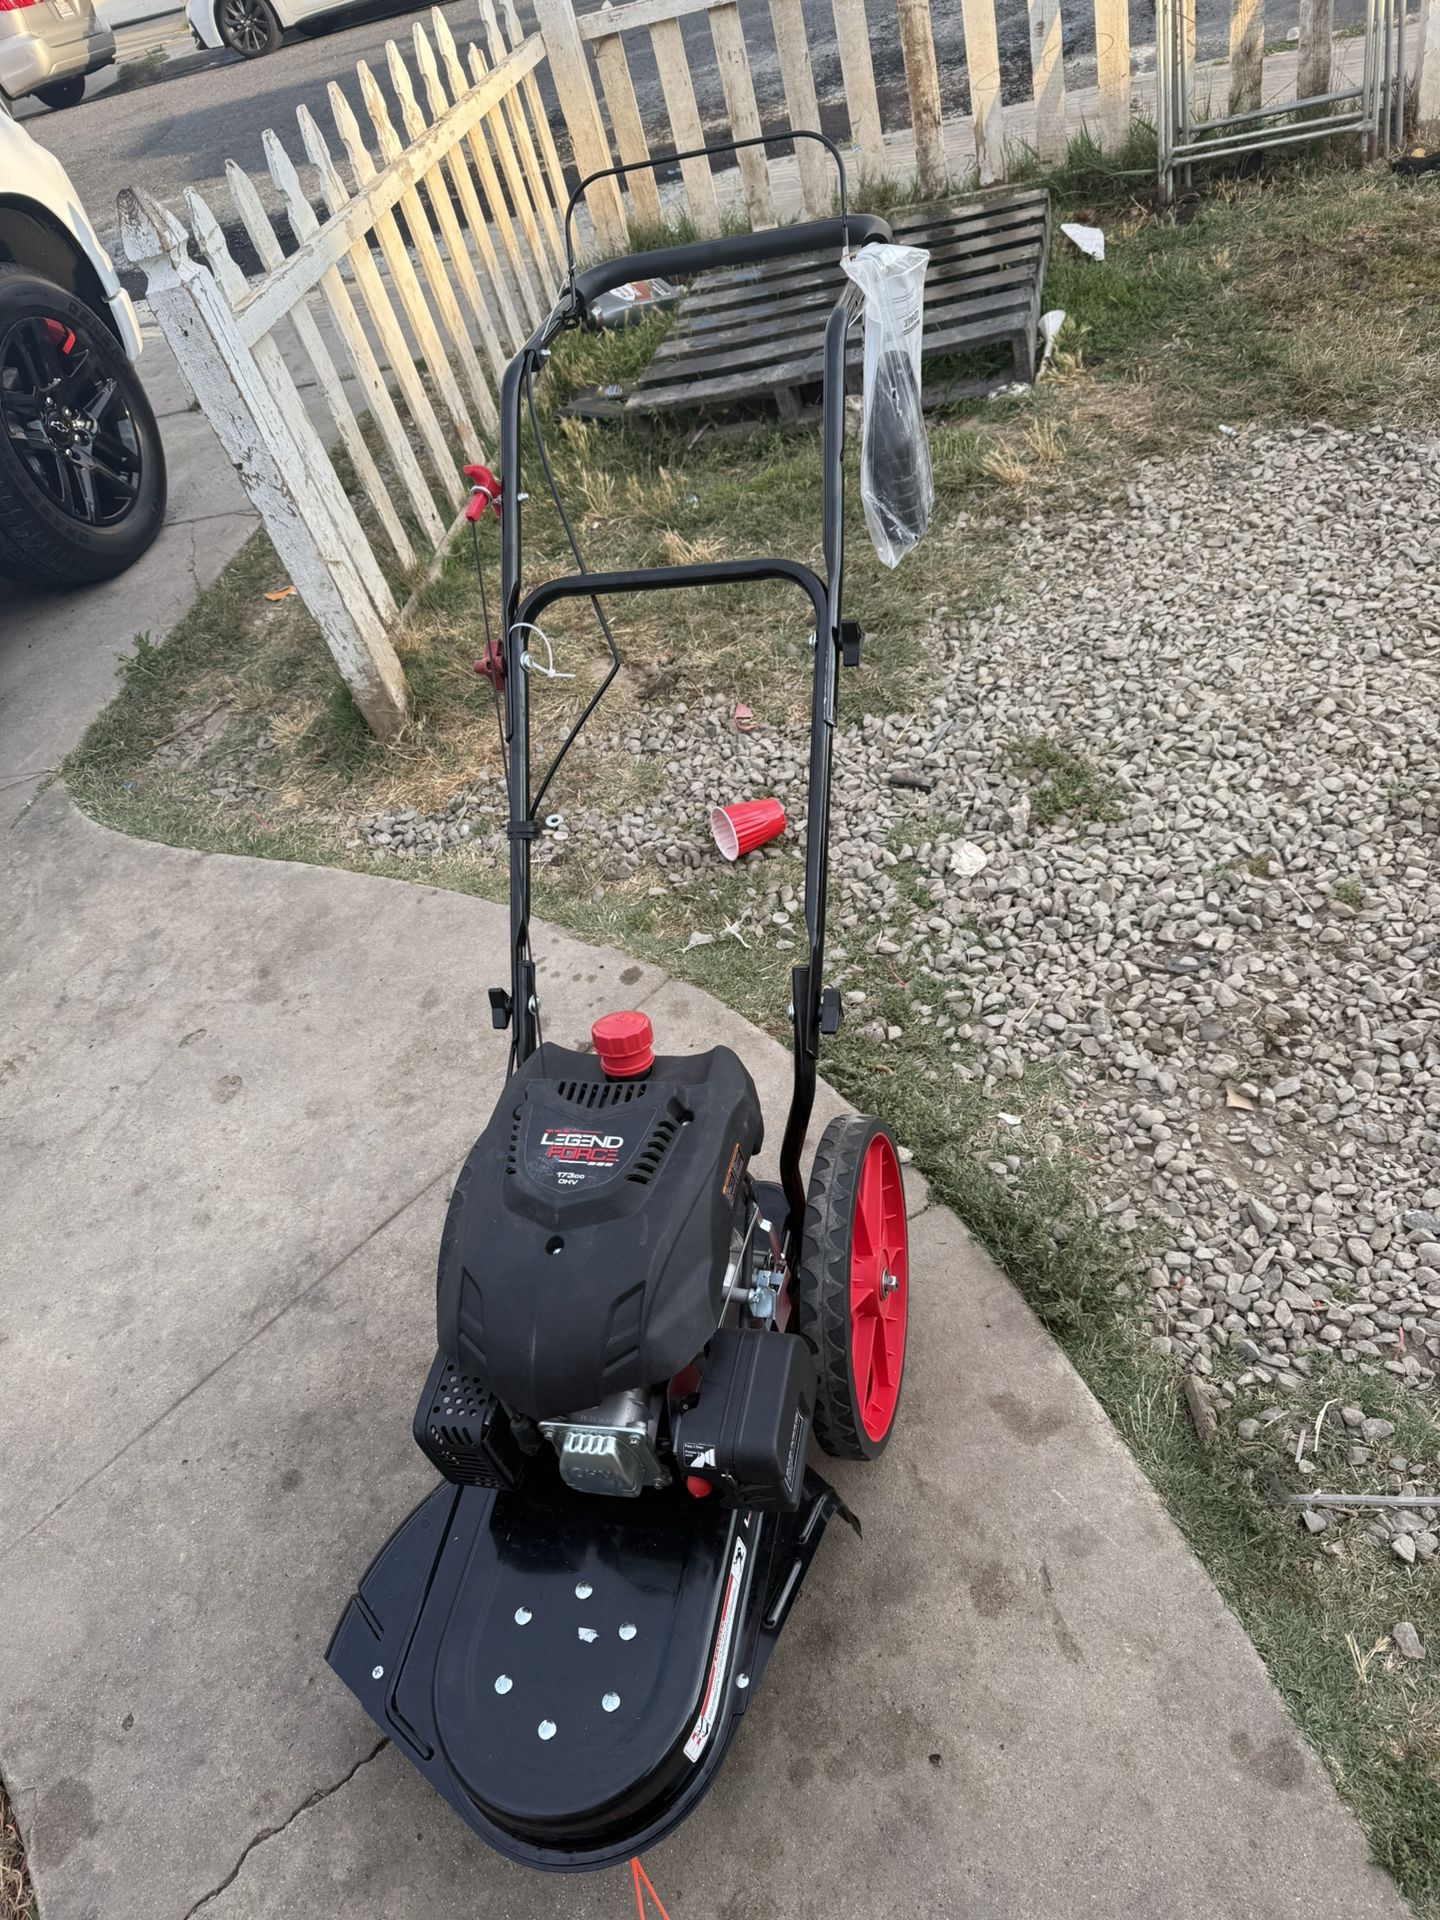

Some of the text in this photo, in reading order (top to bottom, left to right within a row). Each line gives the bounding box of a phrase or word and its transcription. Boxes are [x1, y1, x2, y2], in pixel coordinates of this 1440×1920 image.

[541, 1132, 624, 1149] LEGEND
[547, 1146, 619, 1161] FORCE
[557, 1178, 579, 1186] OHV
